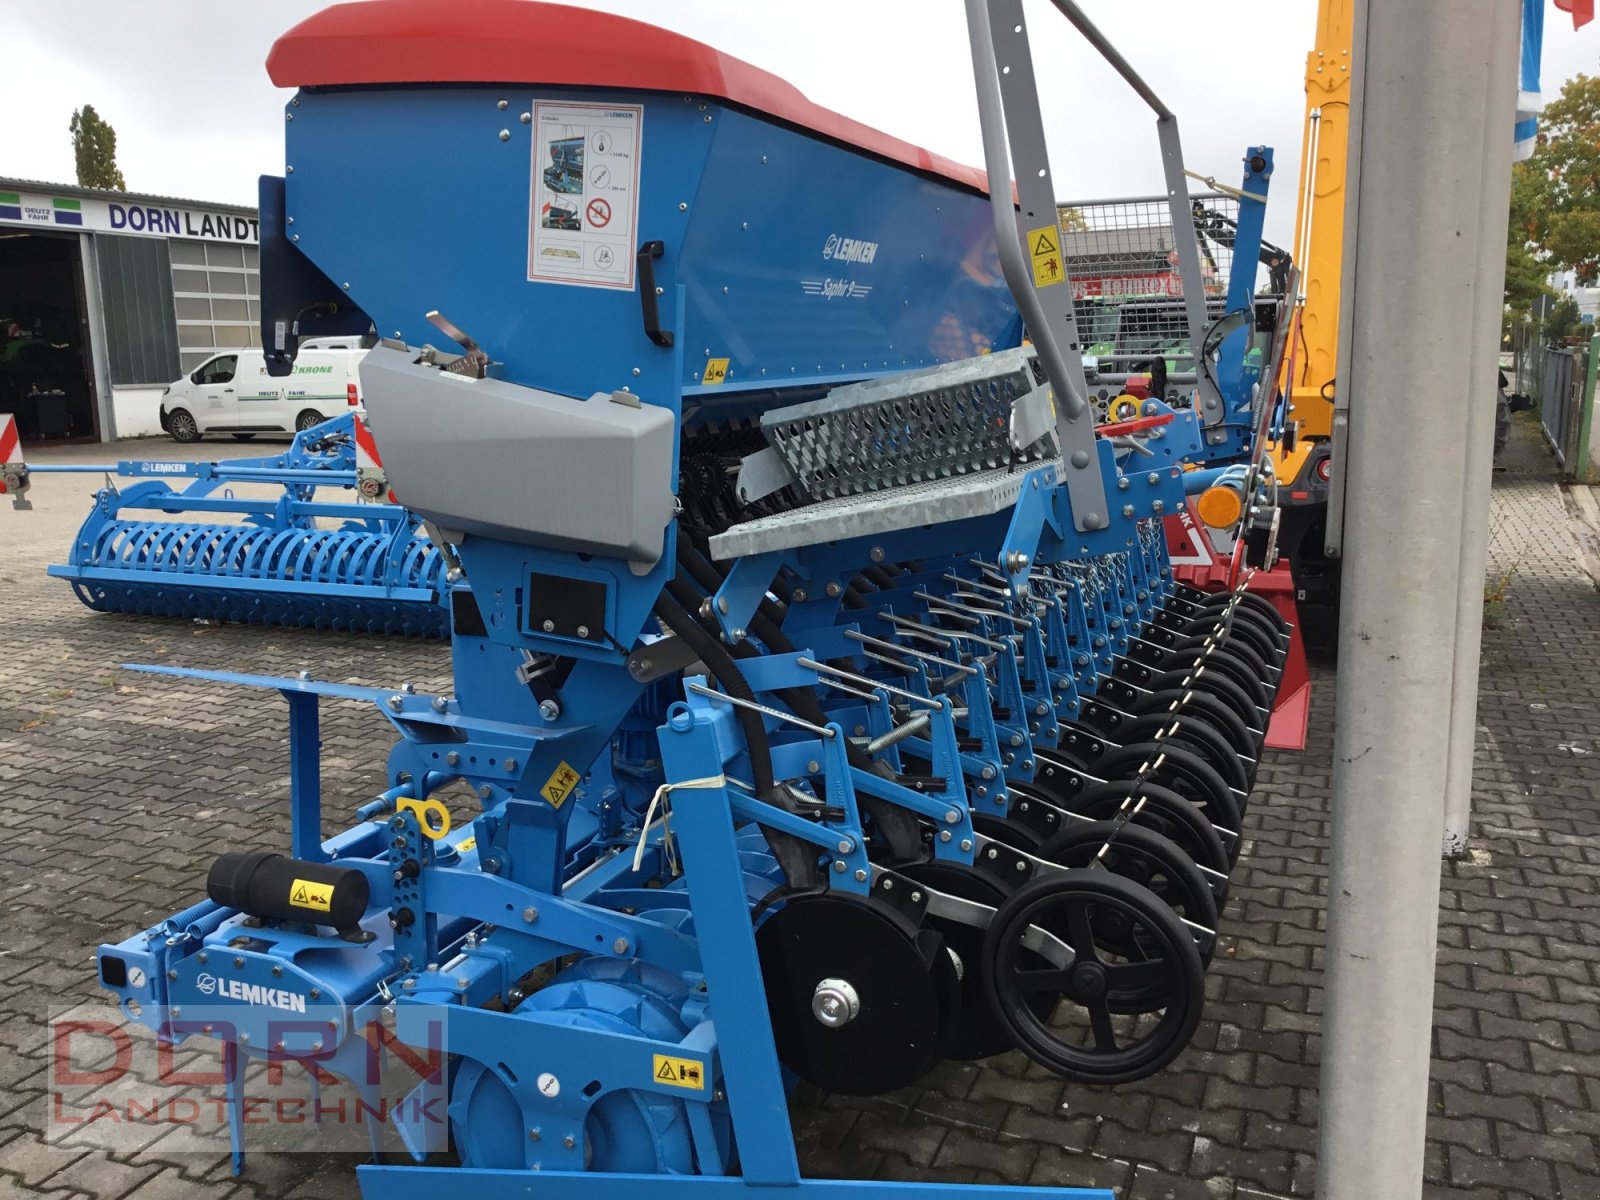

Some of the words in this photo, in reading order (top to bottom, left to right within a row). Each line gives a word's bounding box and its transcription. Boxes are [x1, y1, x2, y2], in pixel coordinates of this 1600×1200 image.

[24, 207, 51, 215] DEUTZ
[27, 213, 50, 221] FAHR
[108, 204, 181, 234] DORN
[833, 237, 878, 265] LEMKEN
[821, 278, 848, 300] Saphir
[846, 280, 856, 297] 9
[298, 365, 333, 374] KRONE
[150, 463, 187, 474] LEMKEN
[218, 977, 306, 1014] LEMKEN
